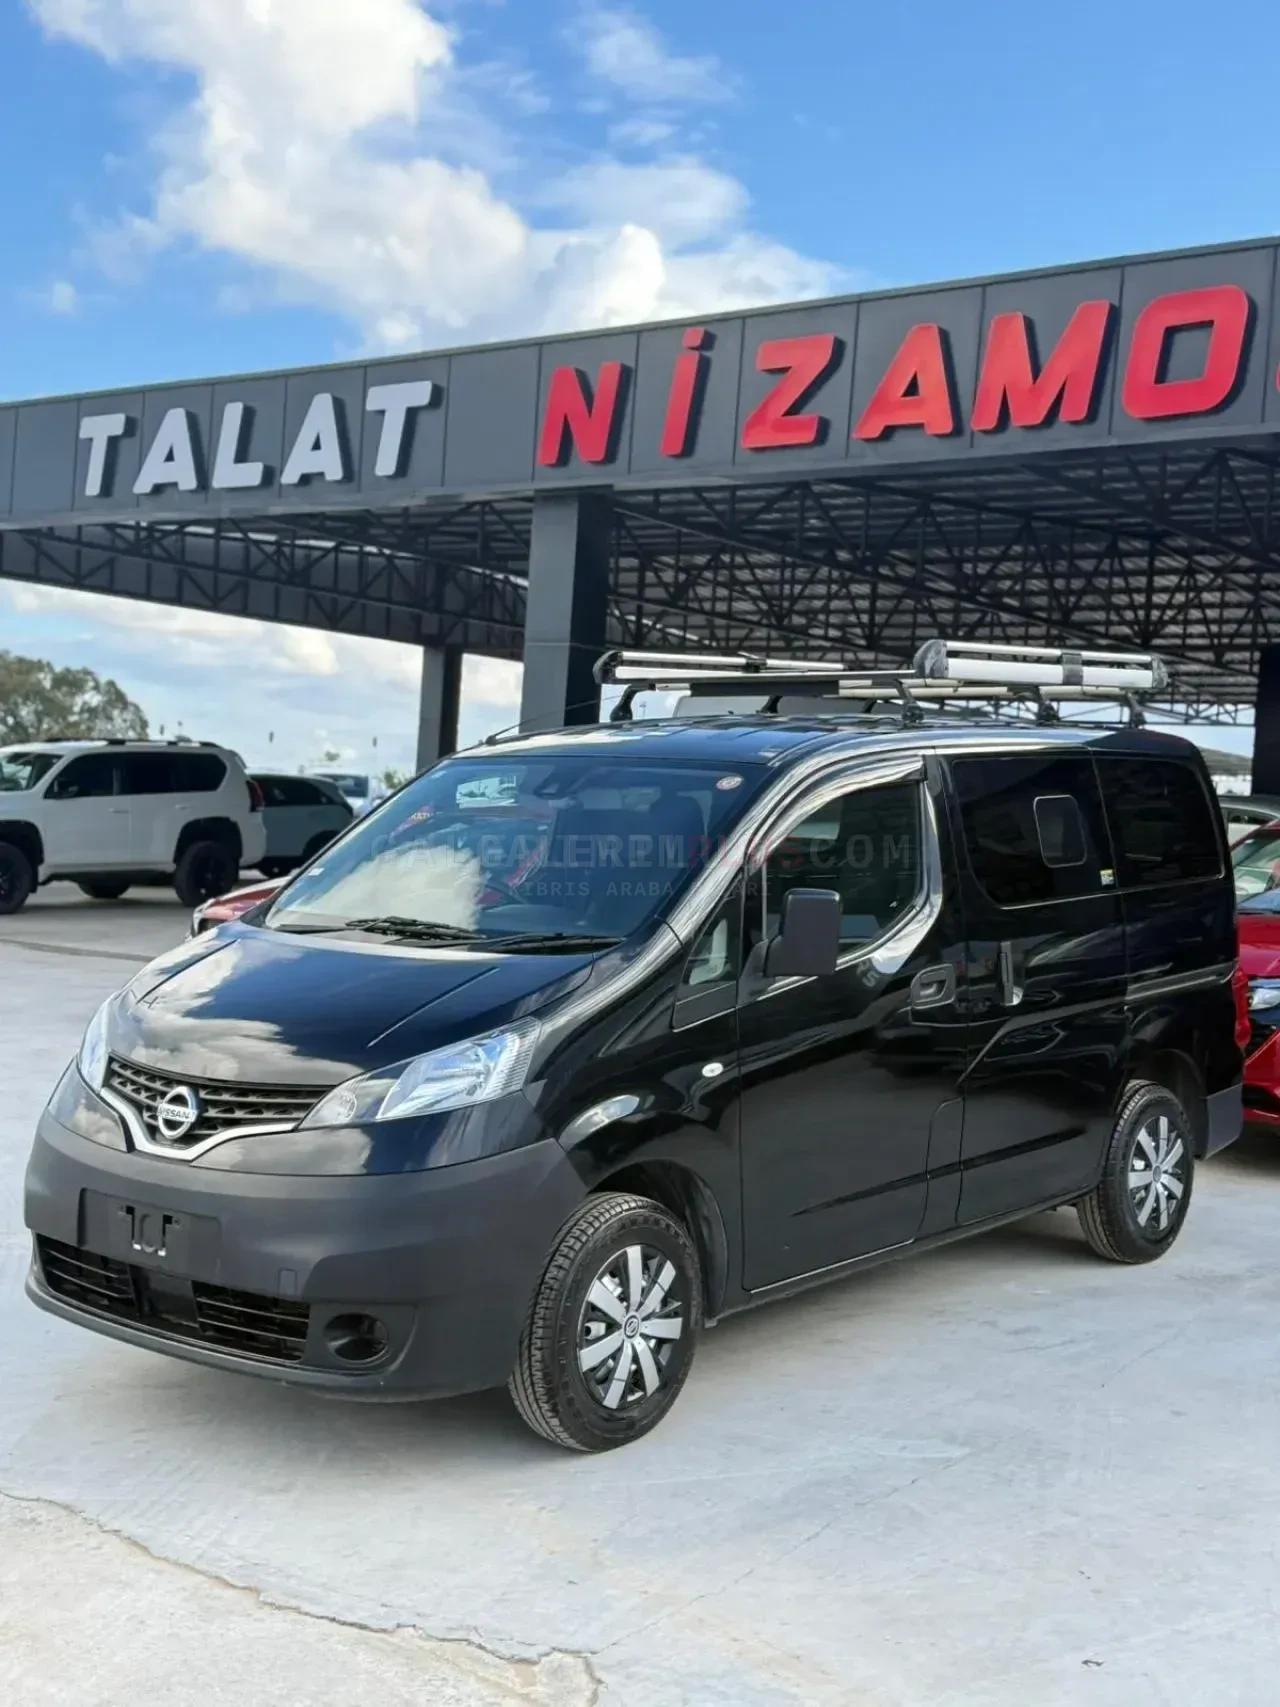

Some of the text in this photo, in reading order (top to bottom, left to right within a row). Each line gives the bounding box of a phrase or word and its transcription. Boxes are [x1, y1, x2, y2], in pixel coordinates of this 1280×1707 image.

[79, 285, 1280, 496] TALAT NİZAMO
[158, 1106, 190, 1119] NISSAN
